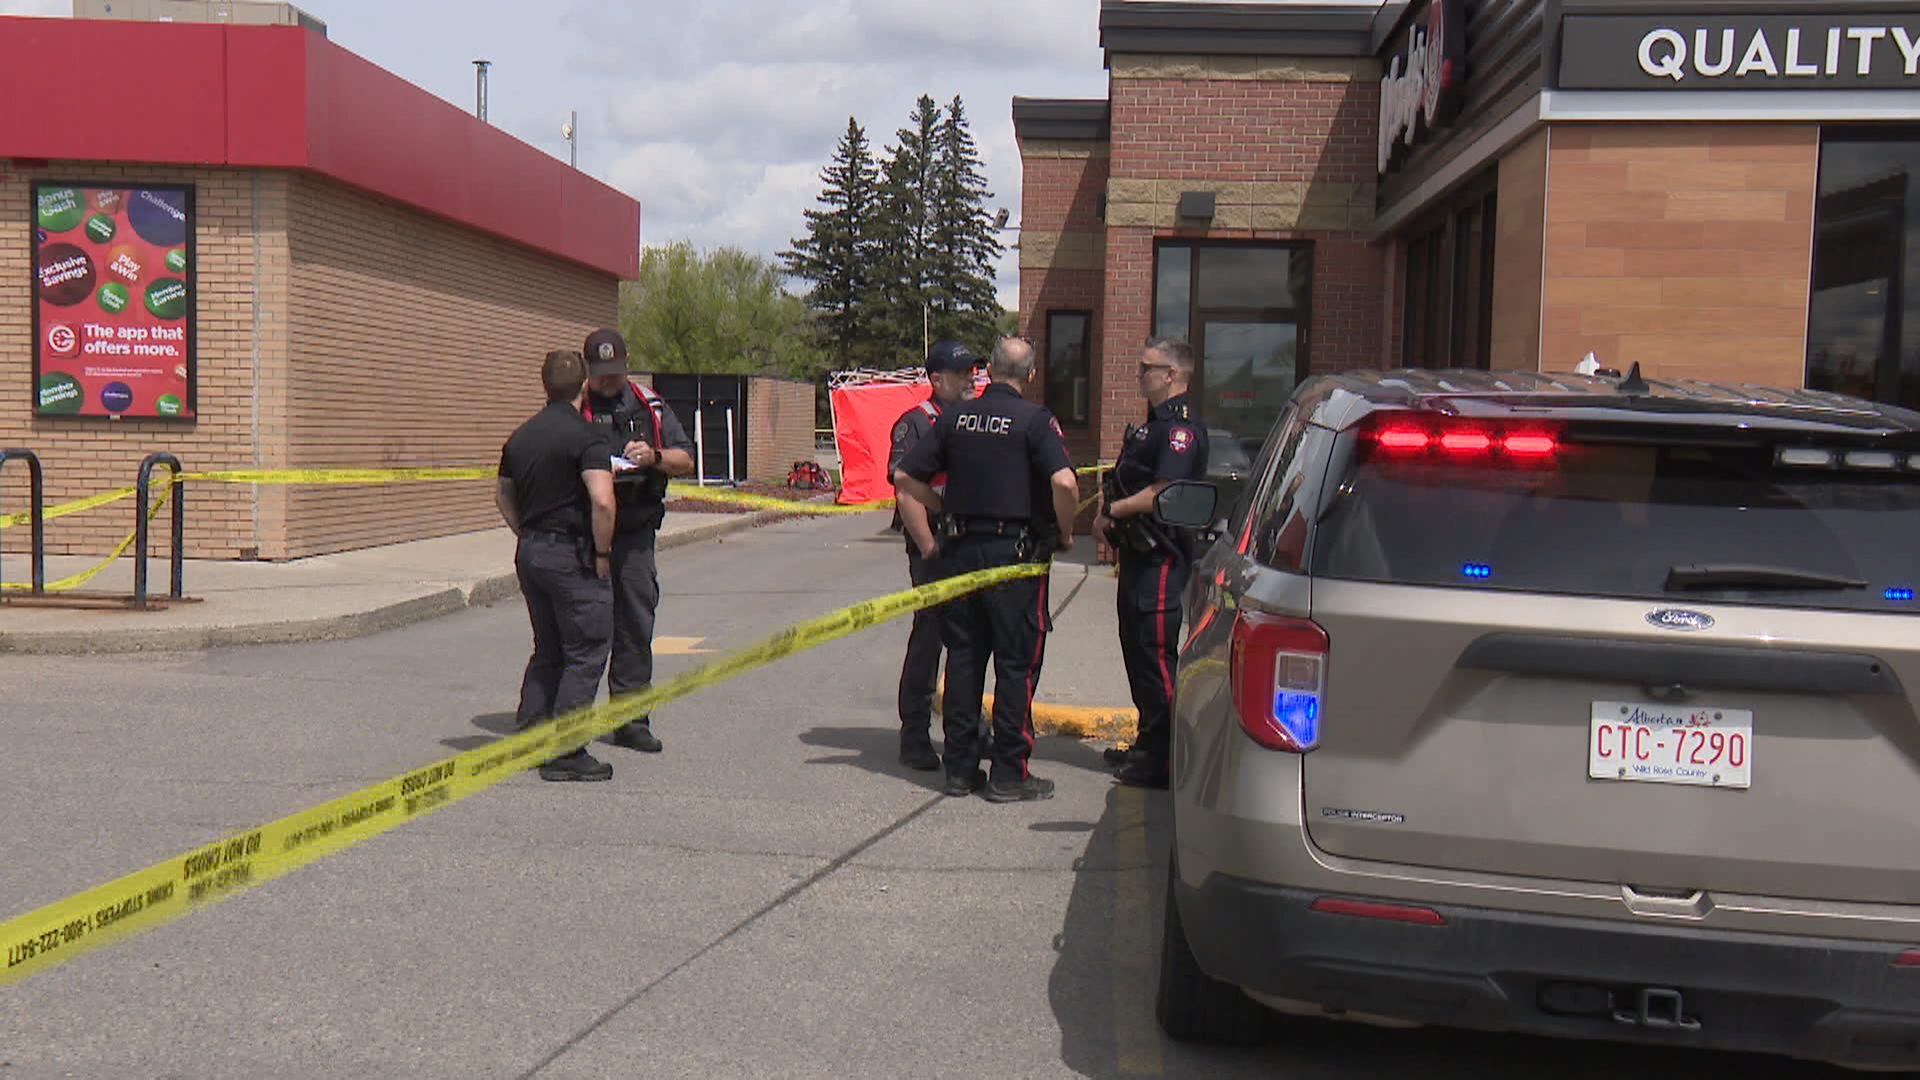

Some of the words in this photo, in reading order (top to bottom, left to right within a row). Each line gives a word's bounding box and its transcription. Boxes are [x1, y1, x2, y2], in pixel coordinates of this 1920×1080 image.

[1638, 26, 1920, 81] QUALITY
[38, 189, 75, 206] Bonus
[38, 256, 88, 279] Exclusive
[117, 254, 141, 272] Play
[43, 266, 89, 288] Savings
[83, 323, 115, 339] The
[117, 327, 149, 341] app
[151, 325, 184, 341] that
[84, 340, 131, 355] offers
[133, 344, 180, 357] more.
[956, 414, 1012, 435] POLICE
[1624, 707, 1677, 726] Alberta
[1598, 724, 1744, 768] CTC-7290
[1631, 764, 1650, 774] Wild
[1653, 765, 1673, 775] Rose
[1675, 767, 1708, 777] Country
[95, 893, 144, 930] STOPPERS
[7, 914, 93, 969] 1-800-222-8477
